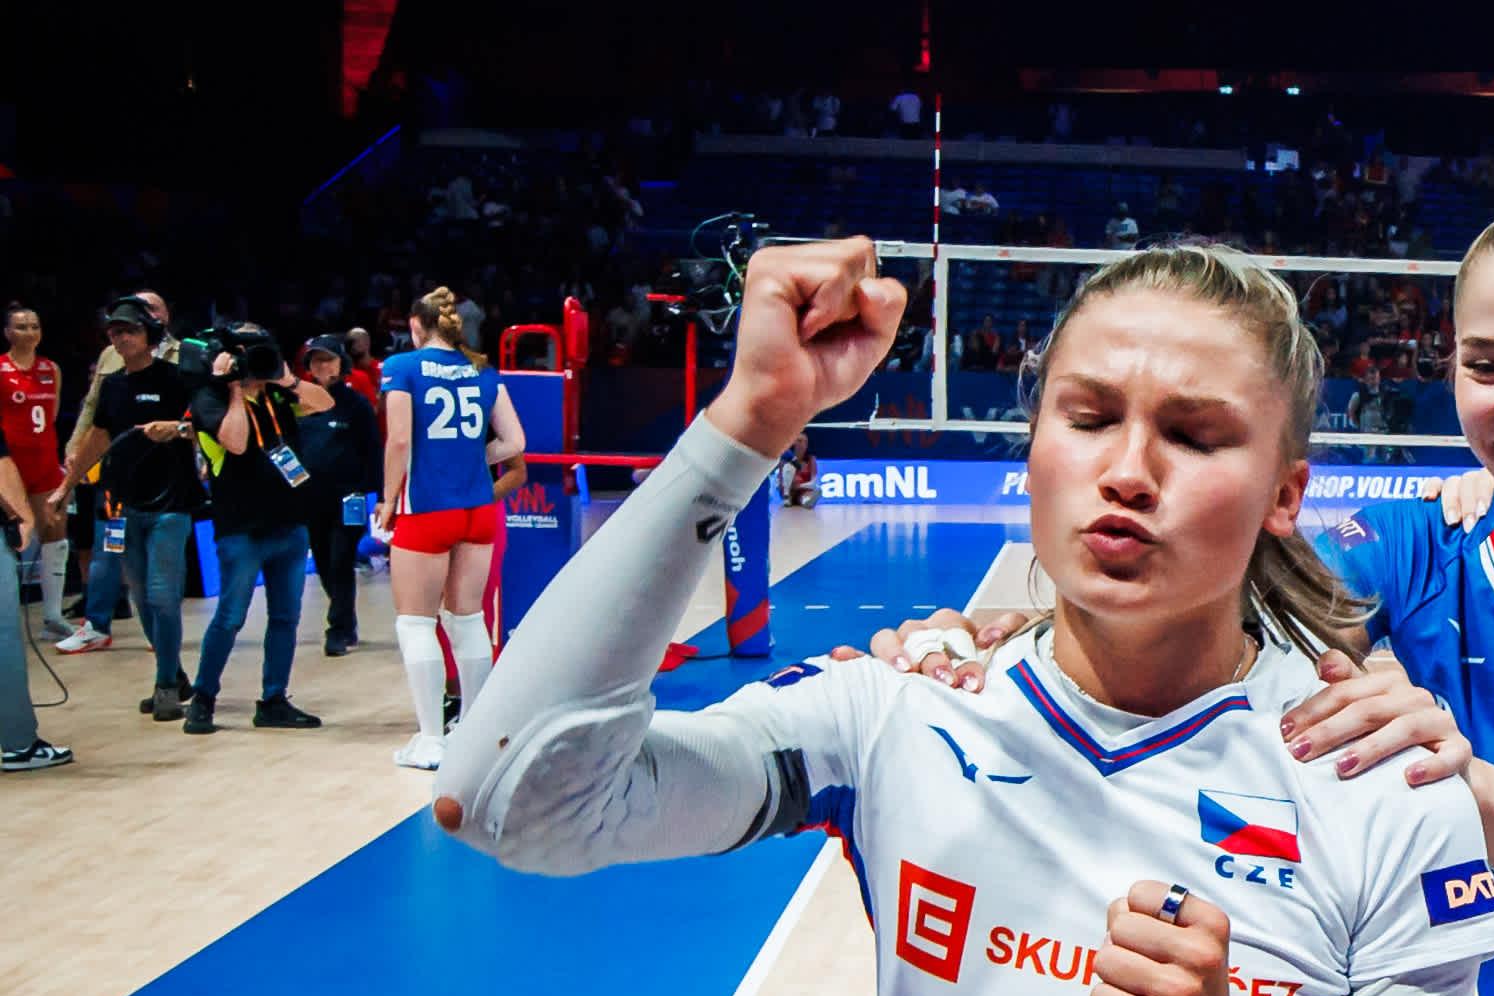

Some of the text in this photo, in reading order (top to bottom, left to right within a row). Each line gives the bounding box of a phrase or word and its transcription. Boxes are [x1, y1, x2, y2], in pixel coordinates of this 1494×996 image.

[31, 405, 46, 434] 9
[424, 386, 484, 440] 25
[820, 466, 937, 499] amNL
[1304, 475, 1427, 499] HOP.VOLLEY
[727, 526, 746, 572] noh
[1213, 853, 1295, 890] CZE
